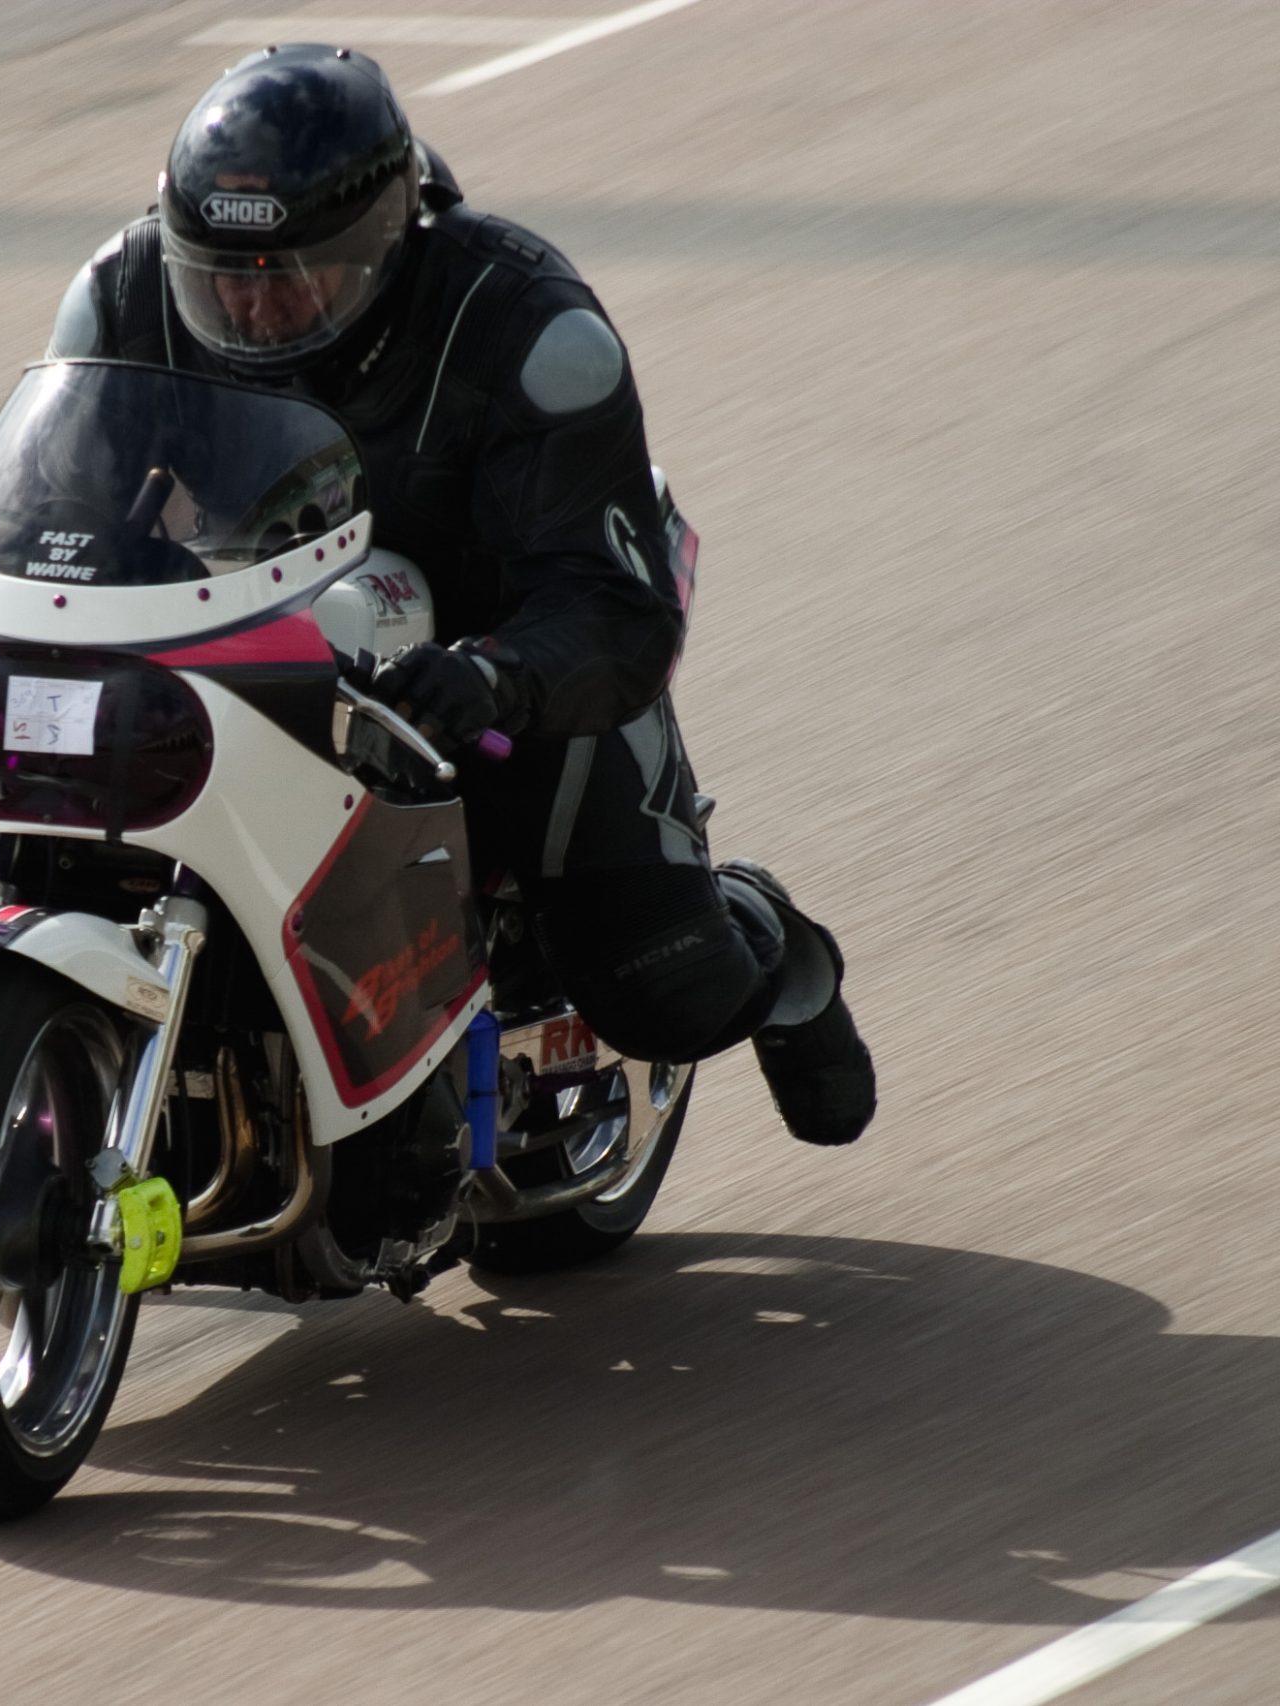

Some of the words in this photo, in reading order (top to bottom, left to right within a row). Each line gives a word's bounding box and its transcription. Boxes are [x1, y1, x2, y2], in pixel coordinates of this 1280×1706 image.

[209, 199, 275, 224] SHOEI
[39, 530, 95, 548] FAST
[48, 547, 79, 562] BY
[25, 561, 98, 581] WAYNE
